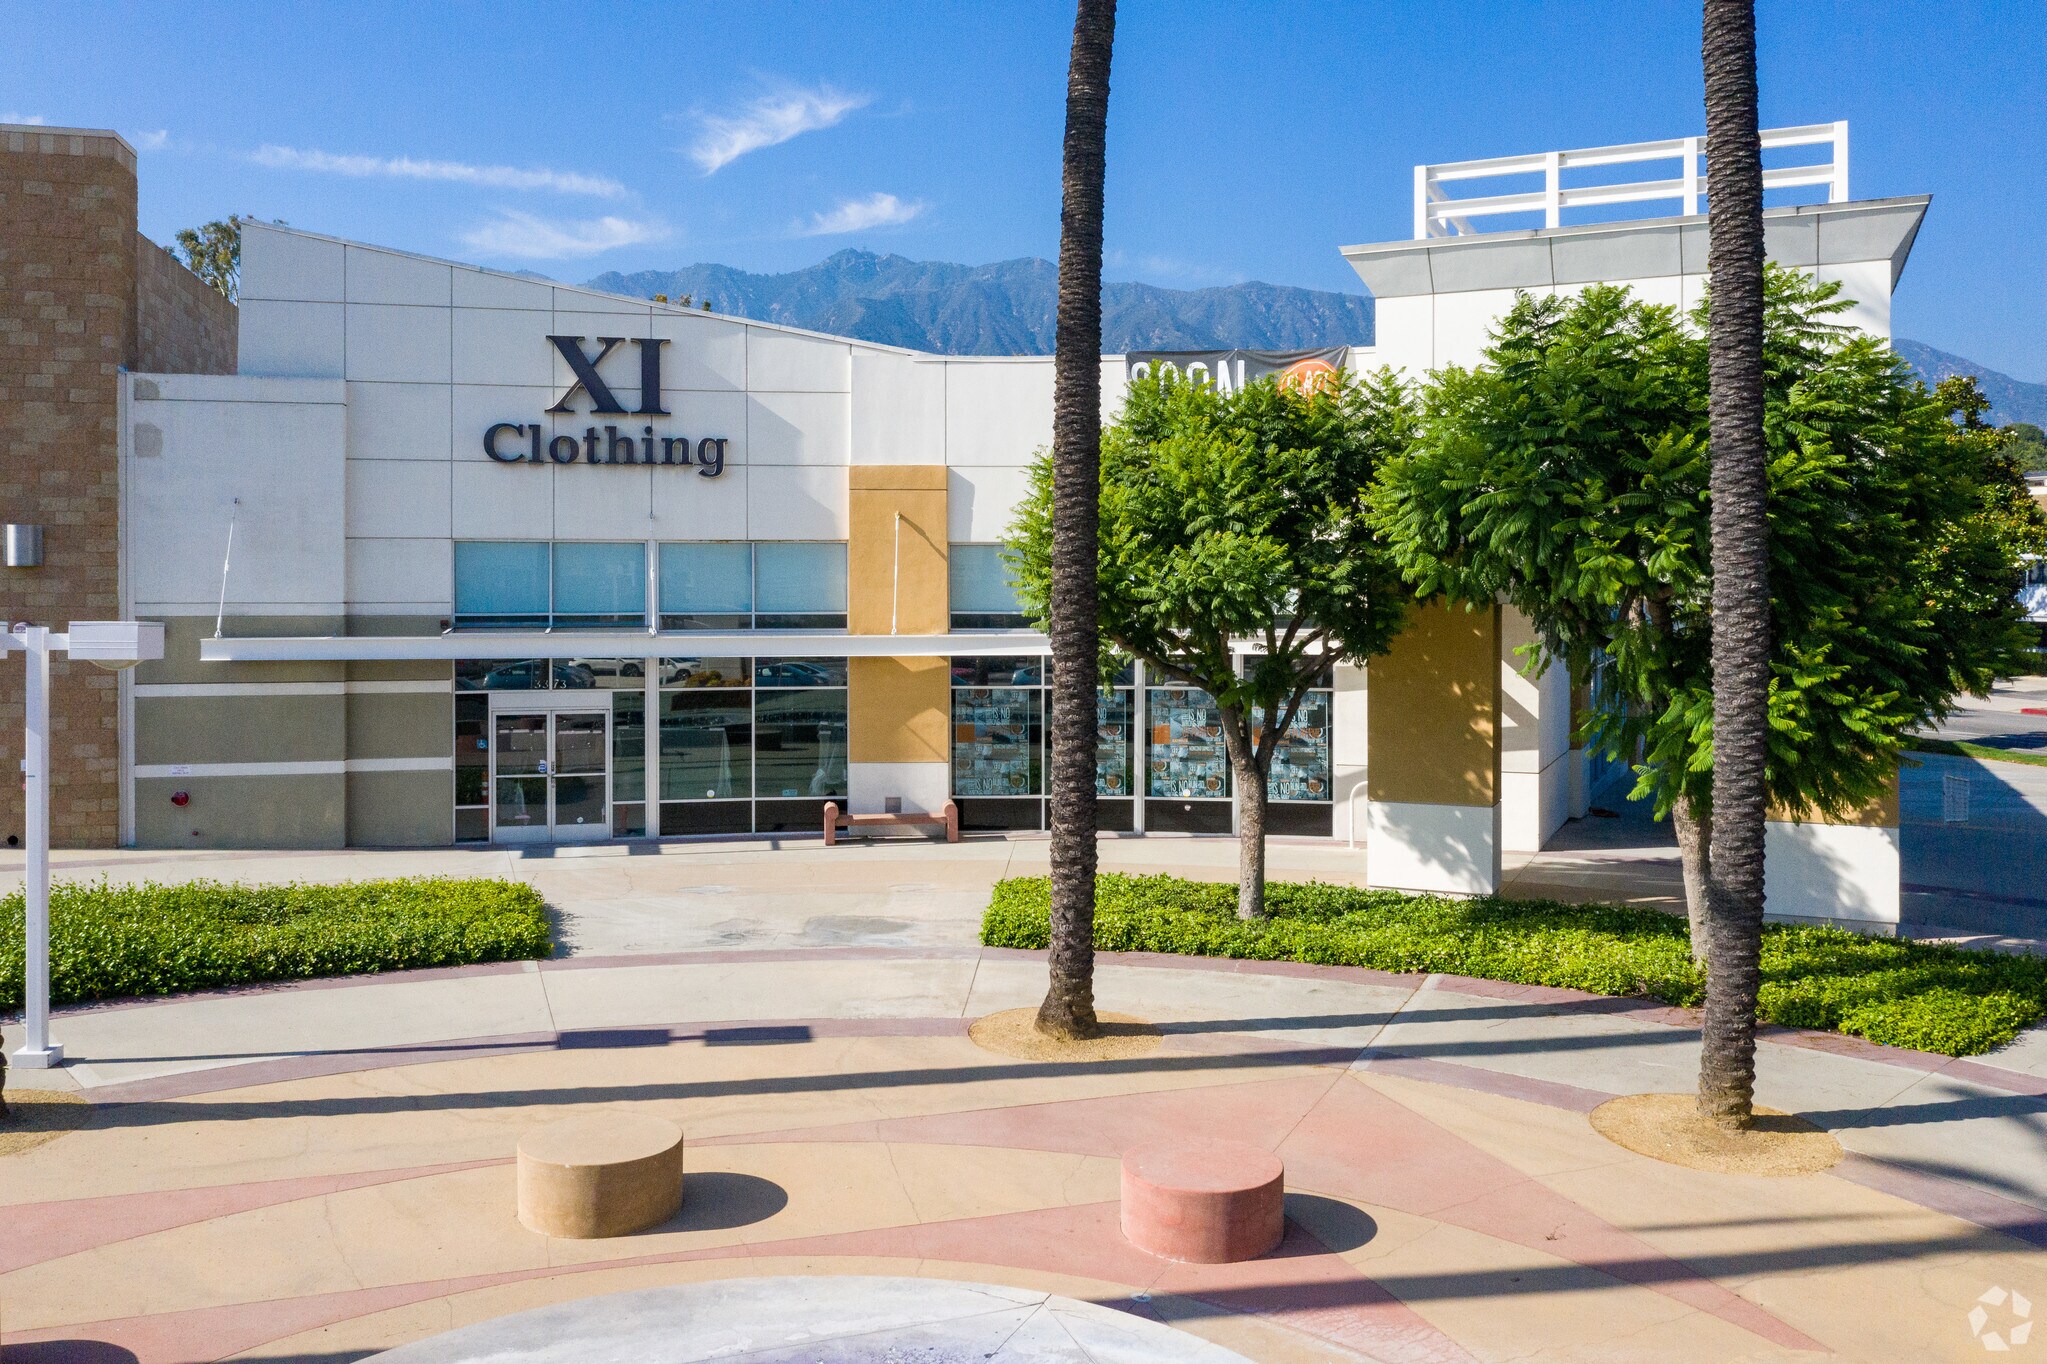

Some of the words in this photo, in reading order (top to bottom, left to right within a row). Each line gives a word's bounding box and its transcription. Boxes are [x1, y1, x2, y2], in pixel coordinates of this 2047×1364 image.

[545, 335, 671, 415] XI
[483, 423, 728, 478] Clothing
[1196, 708, 1207, 721] NO
